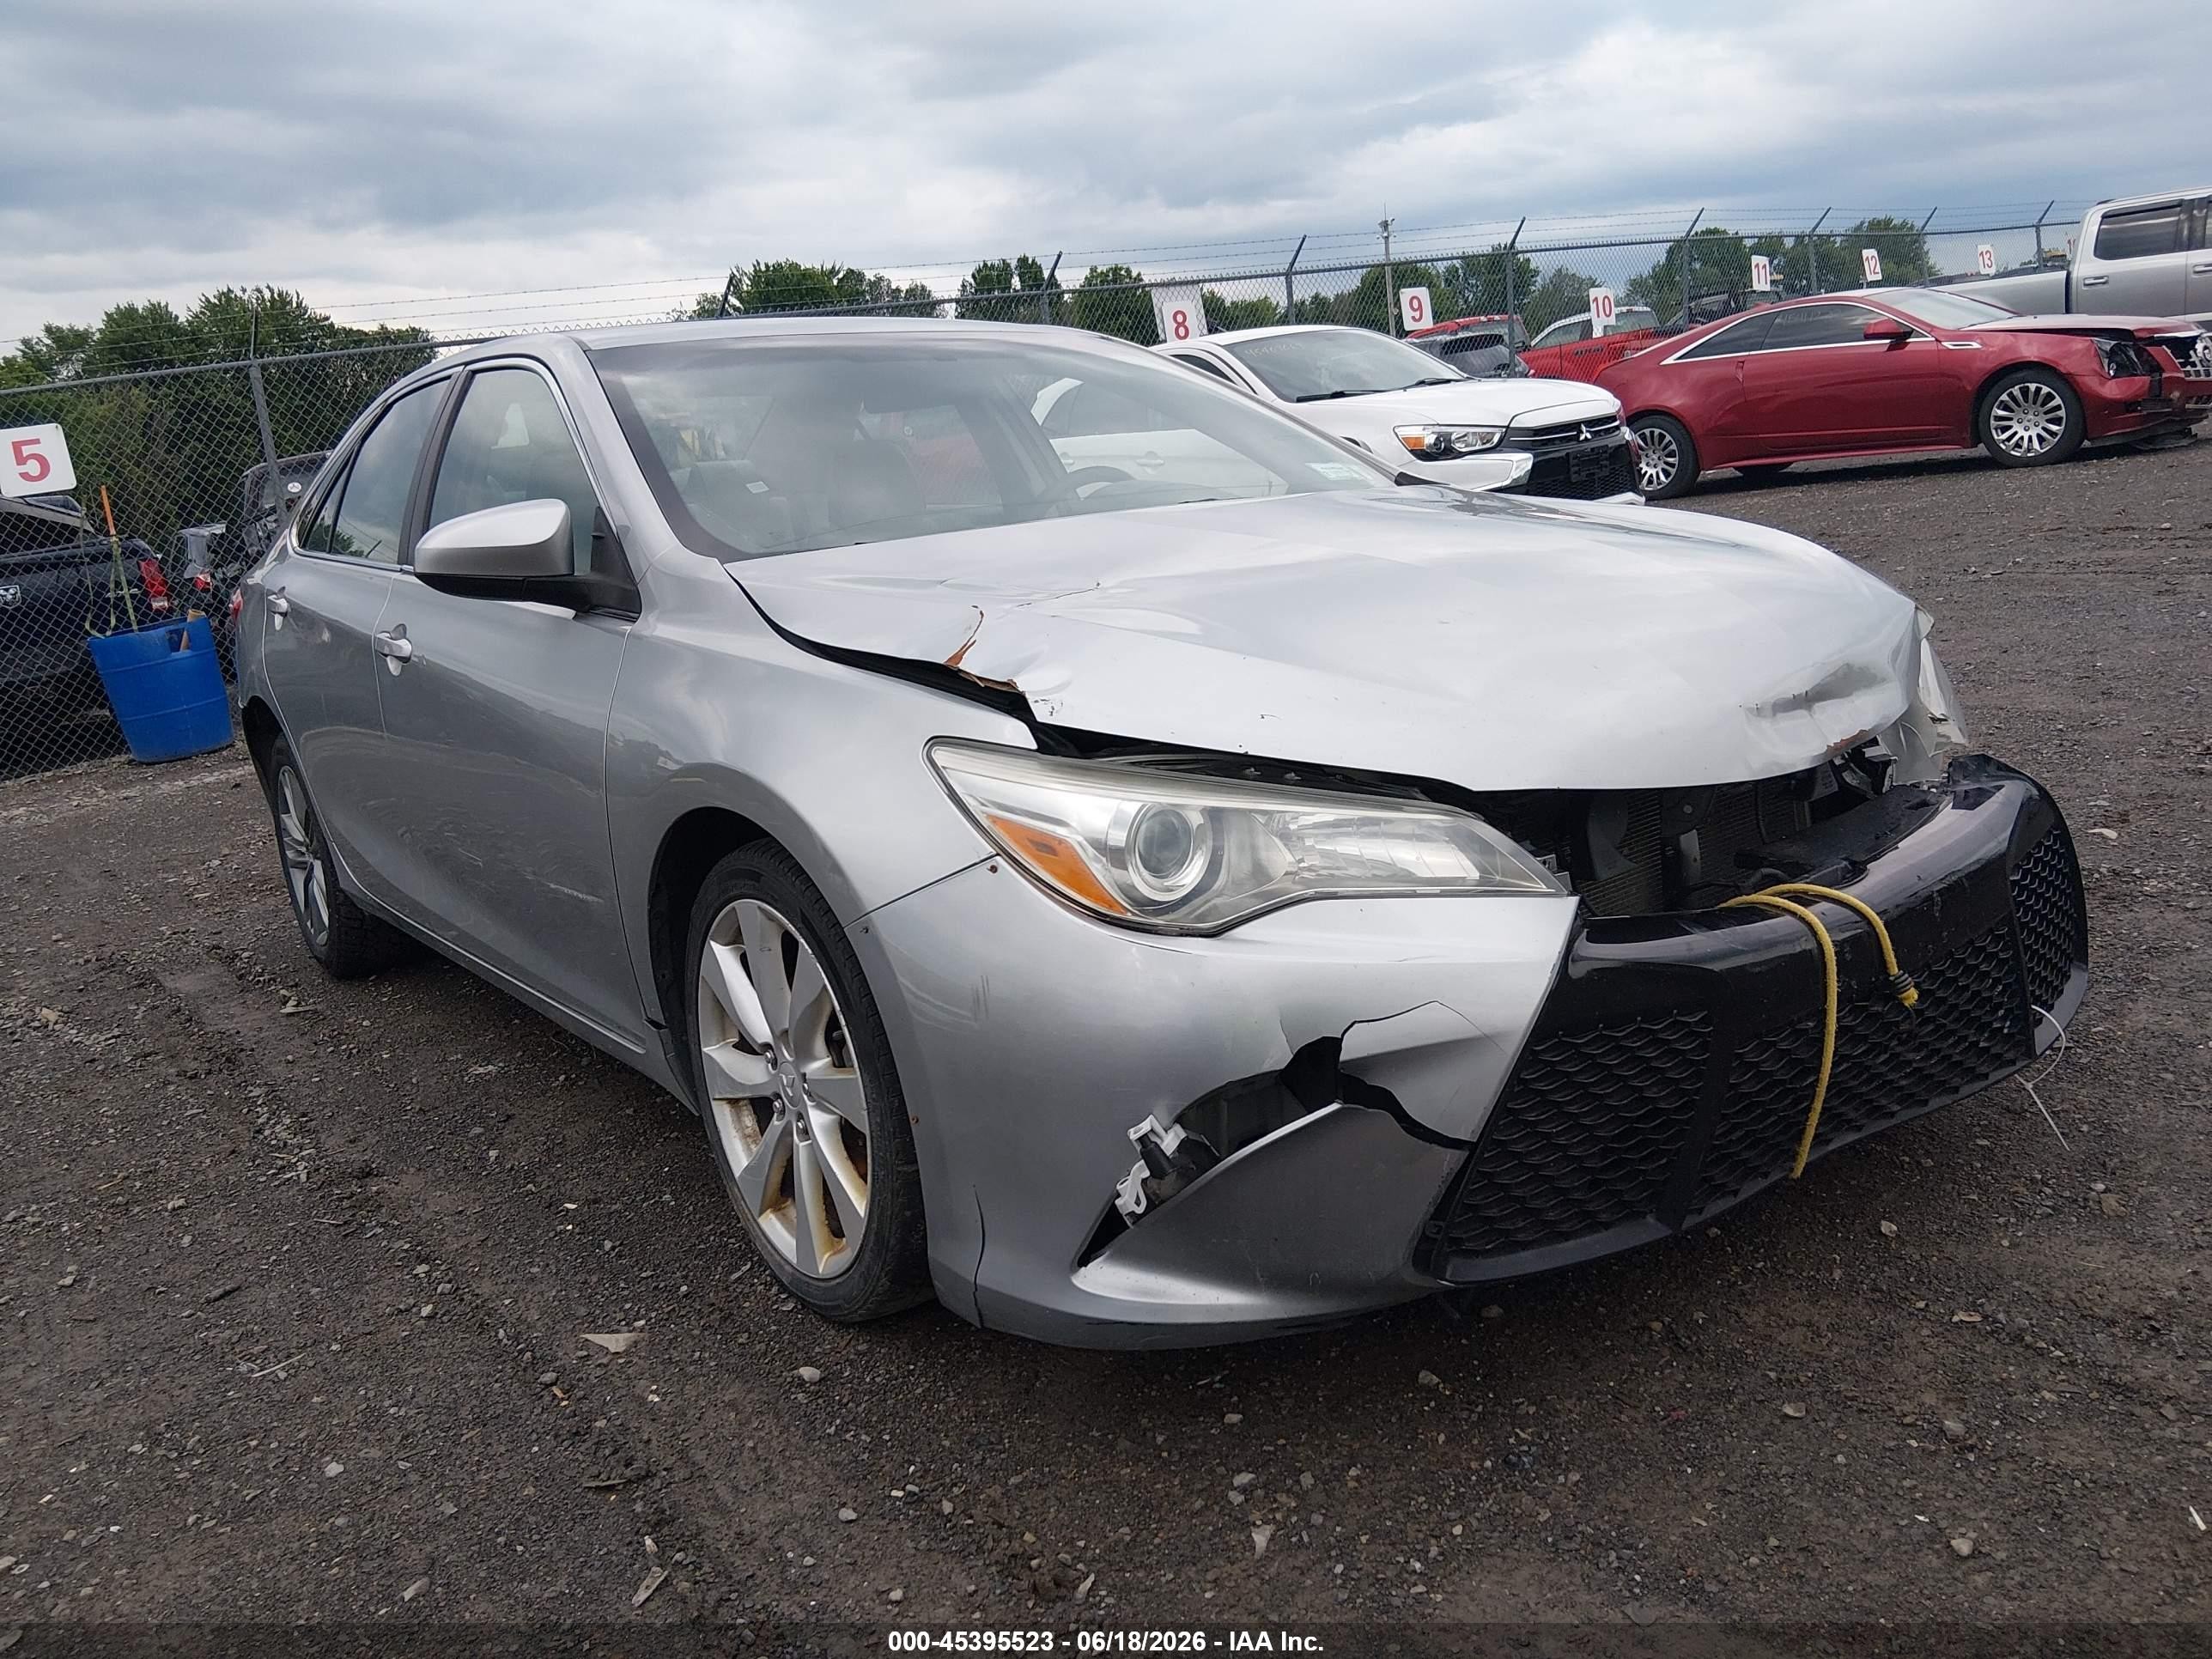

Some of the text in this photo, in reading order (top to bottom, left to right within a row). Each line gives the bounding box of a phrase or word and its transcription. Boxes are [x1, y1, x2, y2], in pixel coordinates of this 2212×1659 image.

[1865, 255, 1880, 275] 12
[1978, 250, 1993, 269] 13
[1754, 262, 1768, 285] 11
[1408, 295, 1424, 323] 9
[1592, 295, 1613, 319] 10
[1172, 310, 1190, 341] 8
[11, 438, 51, 483] 5
